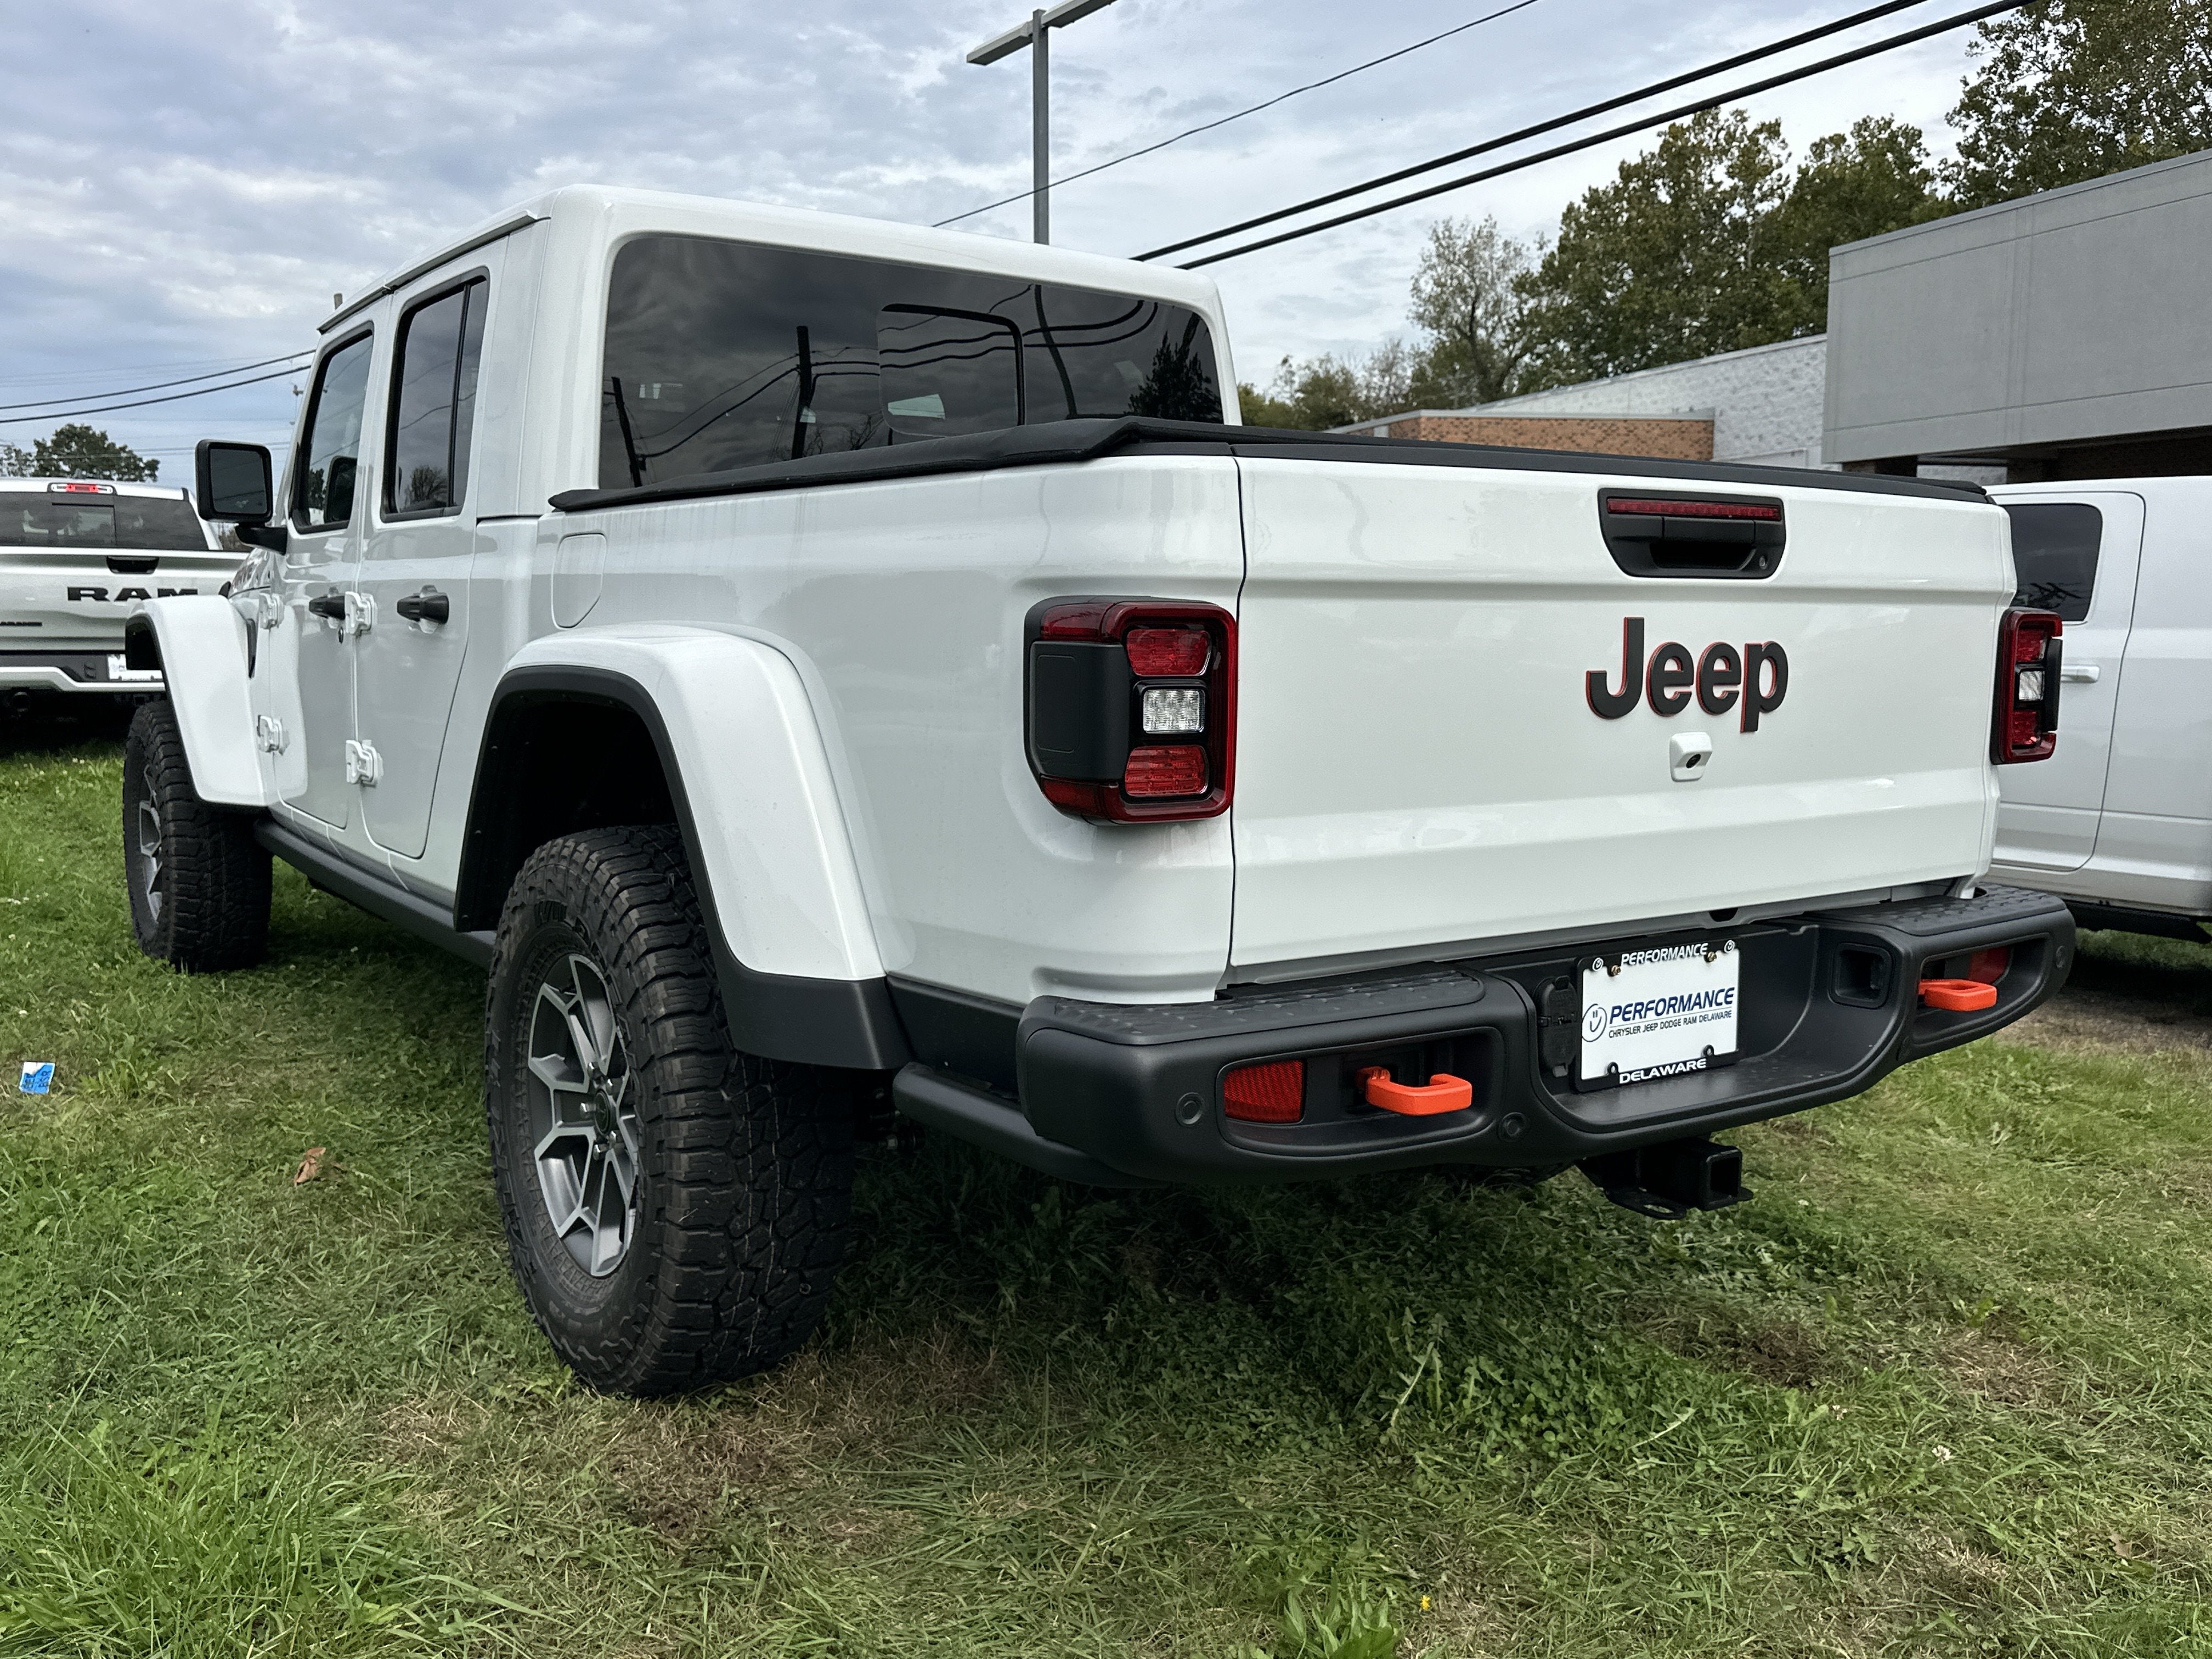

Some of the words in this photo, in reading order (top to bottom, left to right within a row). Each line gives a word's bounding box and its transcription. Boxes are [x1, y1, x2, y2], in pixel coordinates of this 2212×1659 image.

[1585, 617, 1788, 733] Jeep
[1620, 943, 1708, 966] PERFORMANCE
[1609, 987, 1735, 1024] PERFORMANCE
[1609, 1025, 1641, 1039] CHRYSLER
[1643, 1022, 1658, 1033] JEEP
[1660, 1018, 1681, 1029] DODGE
[1683, 1015, 1697, 1025] RAM
[1699, 1009, 1732, 1023] DELAWARE
[1619, 1058, 1707, 1084] DELAWARE
